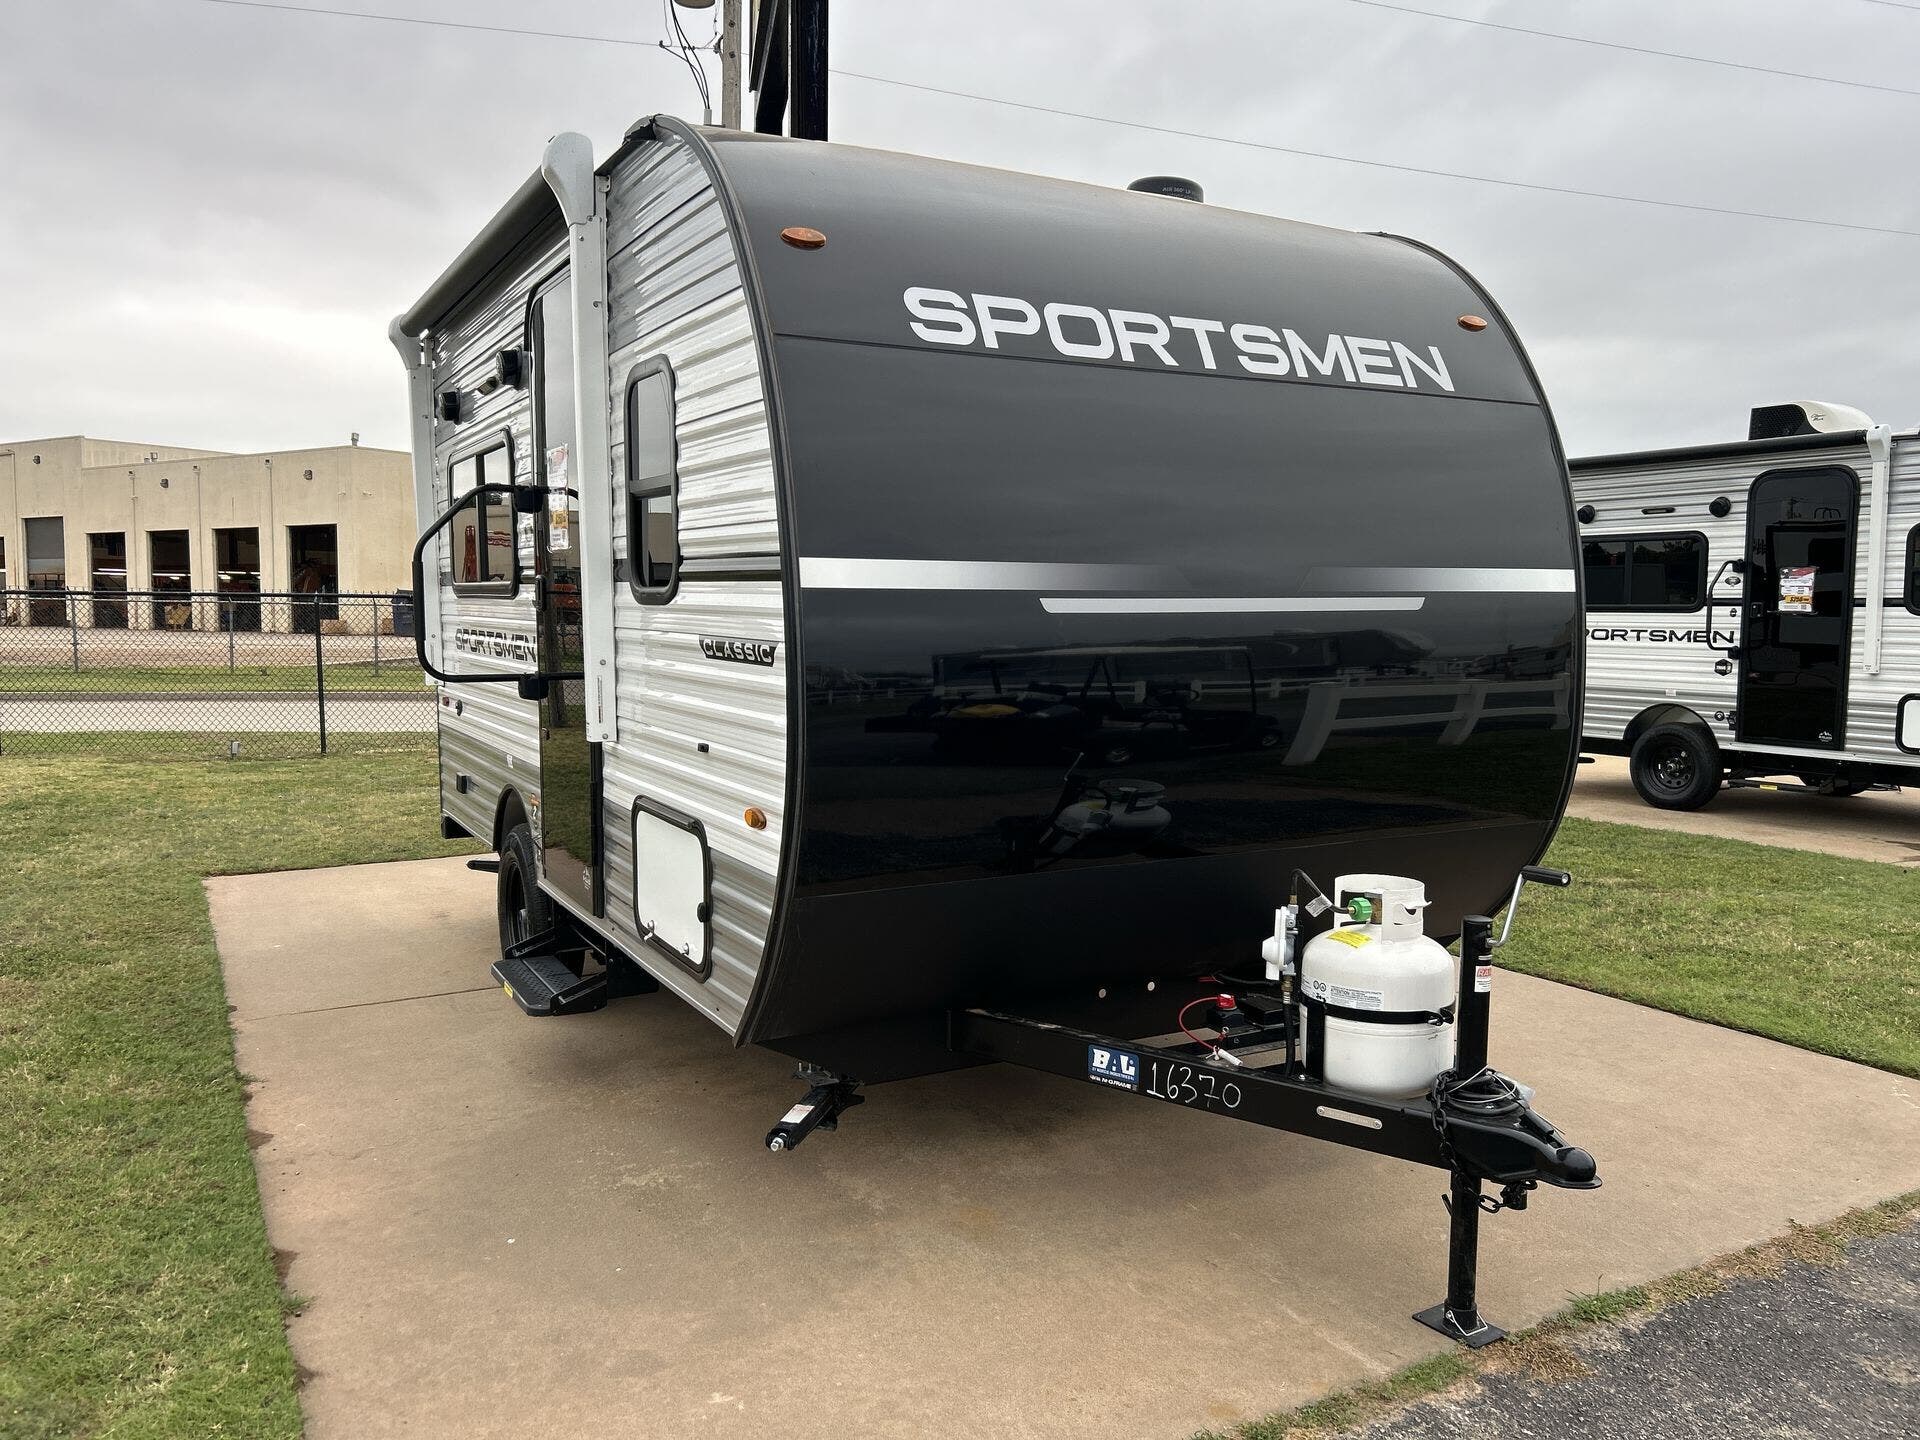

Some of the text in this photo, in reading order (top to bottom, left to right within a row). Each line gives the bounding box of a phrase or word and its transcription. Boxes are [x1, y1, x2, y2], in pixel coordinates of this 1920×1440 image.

[902, 286, 1454, 392] SPORTSMEN
[455, 628, 537, 663] SPORTSMEN
[703, 638, 772, 663] CLASSIC
[1478, 968, 1491, 977] RA
[1146, 1061, 1242, 1109] 16370
